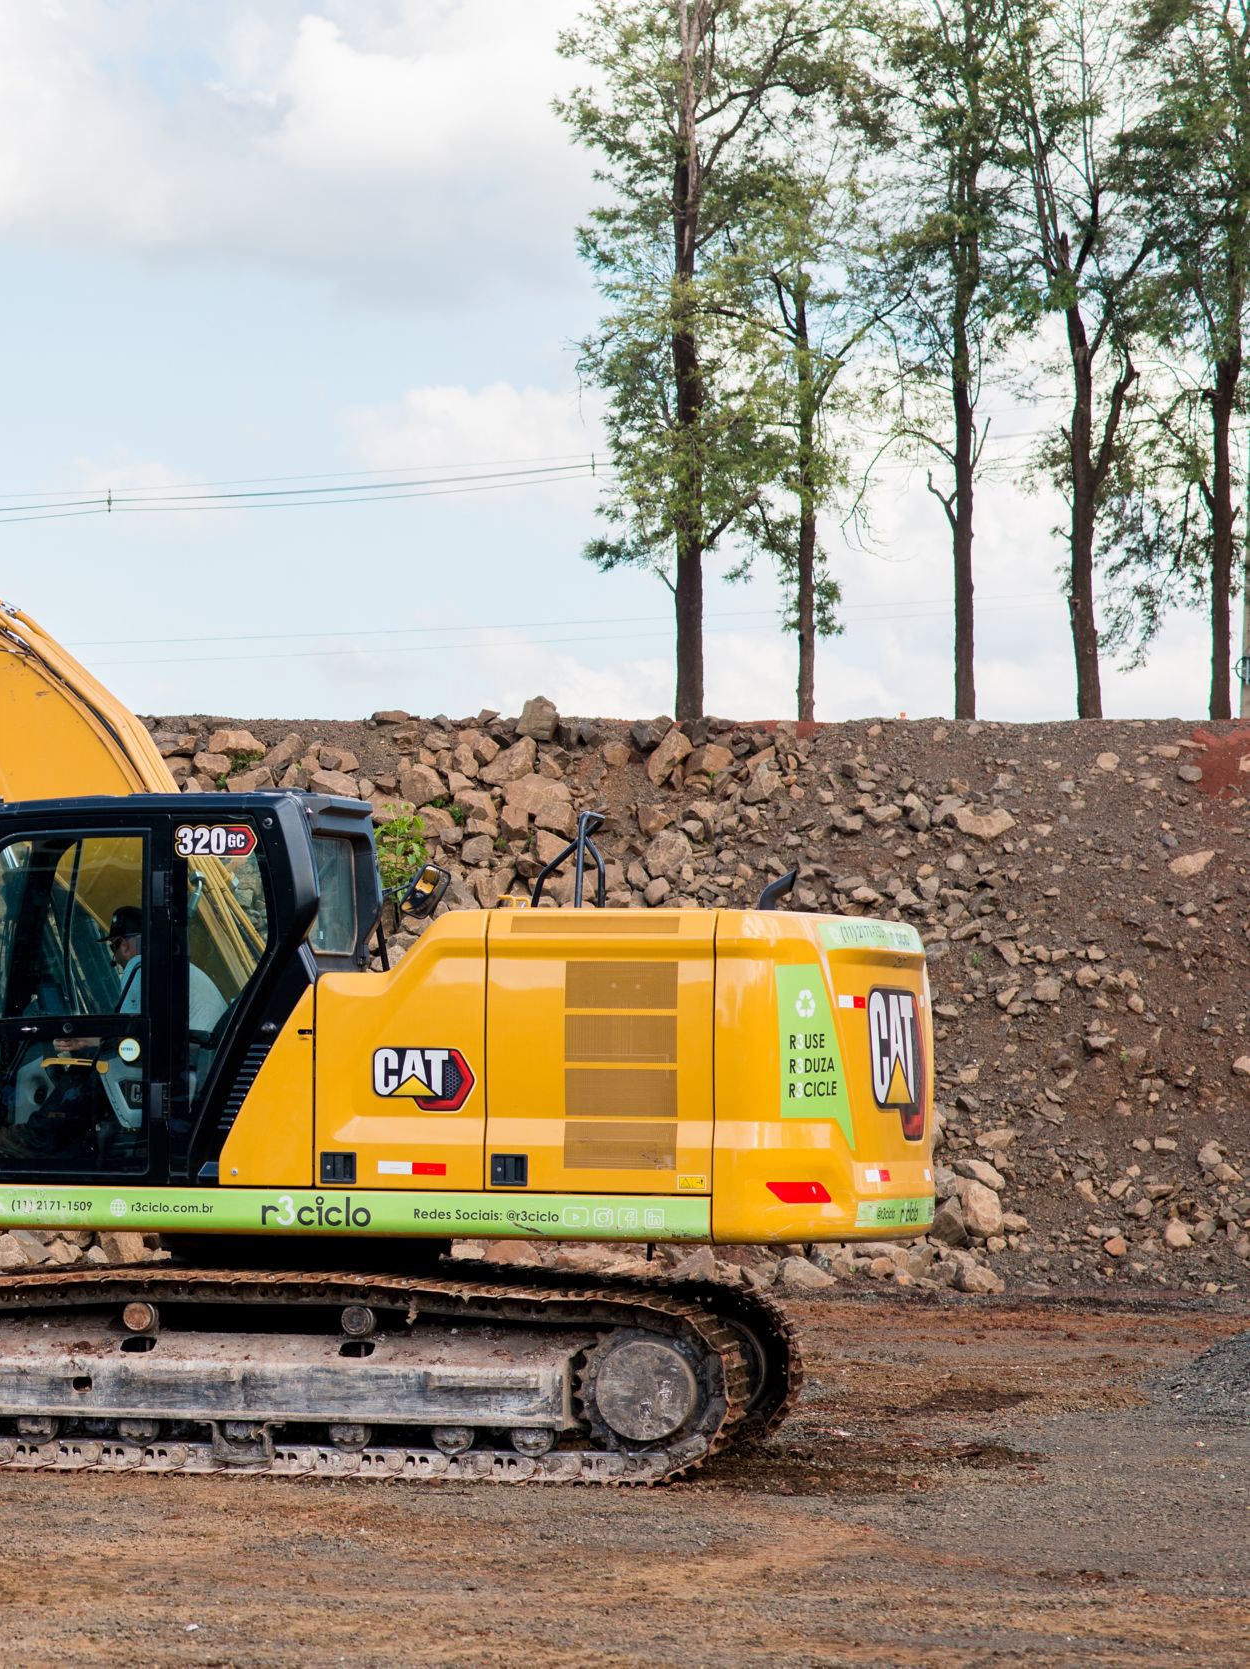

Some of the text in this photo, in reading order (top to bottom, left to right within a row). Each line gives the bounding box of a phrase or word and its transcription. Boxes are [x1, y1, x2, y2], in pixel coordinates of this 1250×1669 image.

[178, 827, 245, 855] 320 GC
[789, 1033, 825, 1050] R3USE
[869, 991, 915, 1104] CAT
[374, 1048, 449, 1096] CAT
[789, 1056, 835, 1074] R3DUZA
[788, 1080, 837, 1099] R3CICLE
[11, 1199, 93, 1212] (11) 2171-1509
[131, 1202, 214, 1214] r3ciclo.com.br
[261, 1195, 372, 1228] r3ciclo
[413, 1208, 560, 1223] Redes Sociais: @r3ciclo
